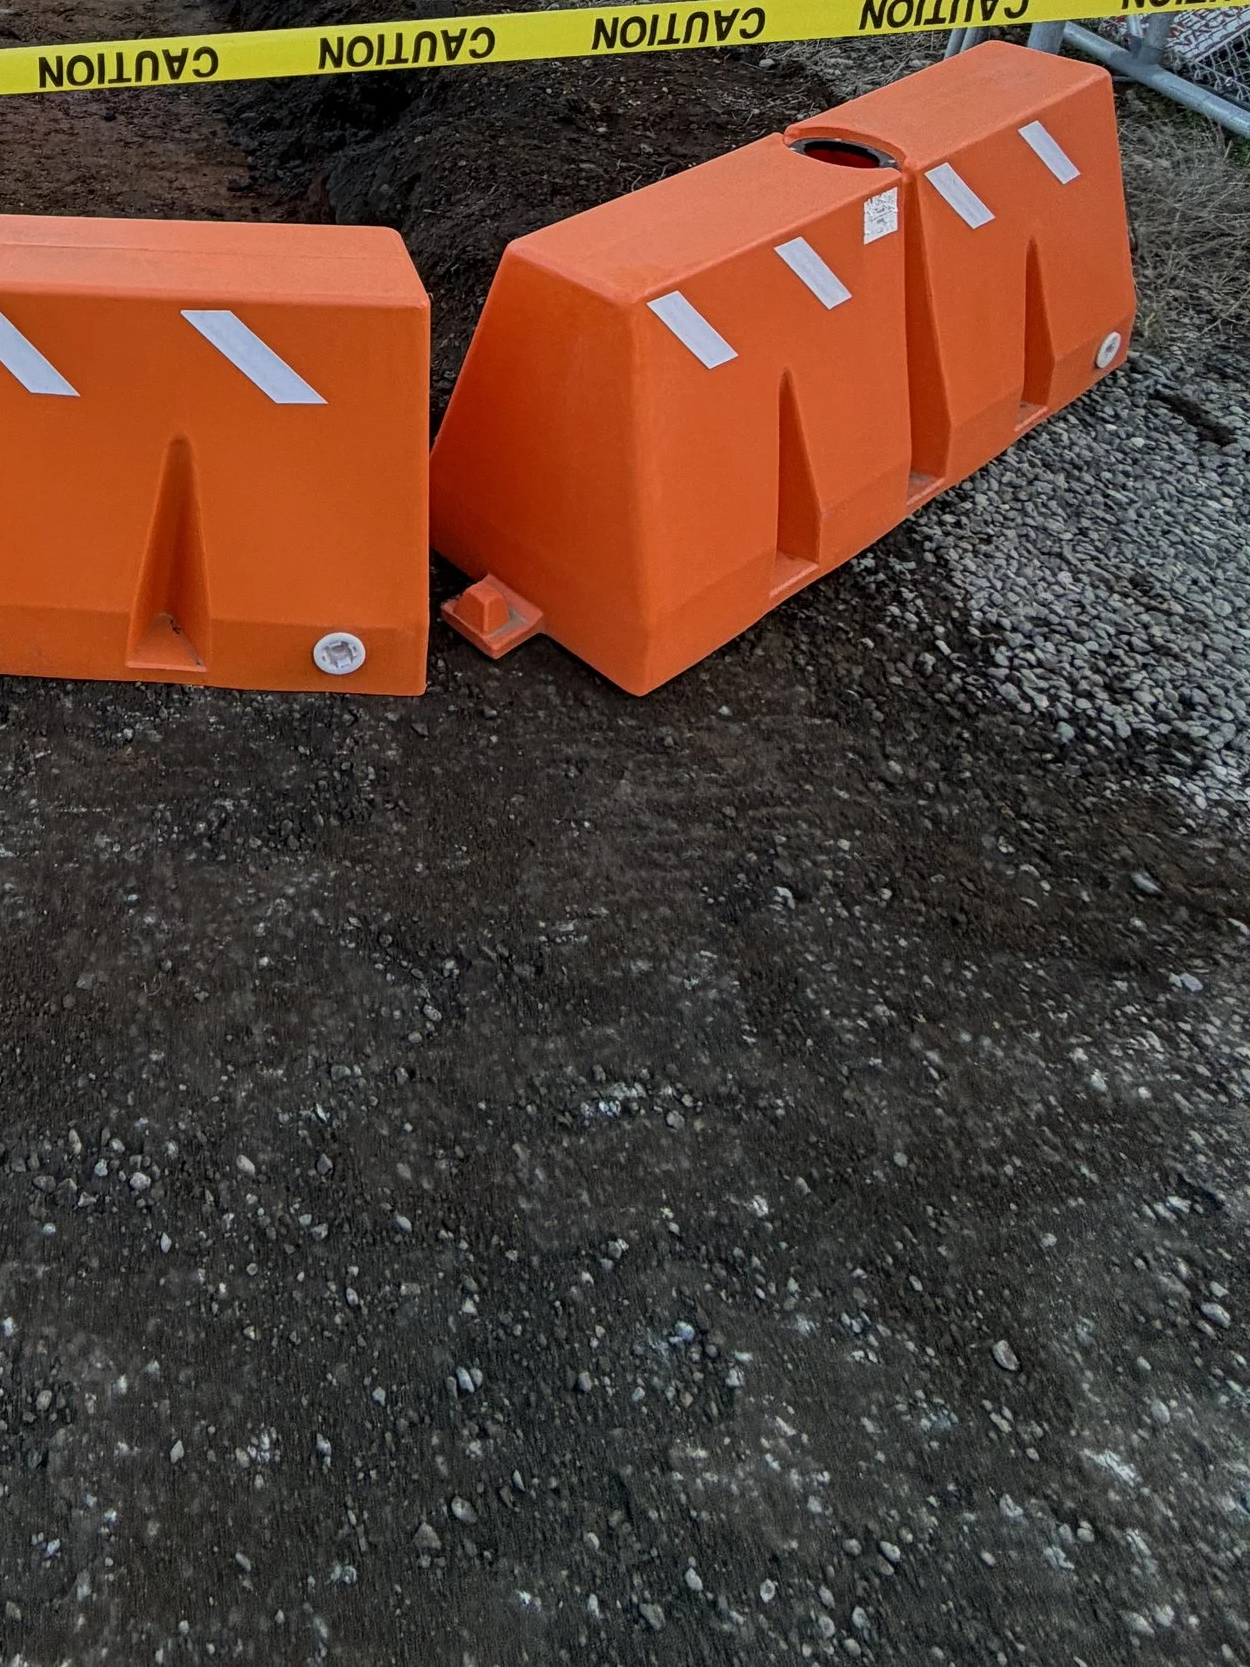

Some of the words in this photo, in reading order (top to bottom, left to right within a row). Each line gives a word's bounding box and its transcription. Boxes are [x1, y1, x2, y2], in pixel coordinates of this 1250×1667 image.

[319, 26, 496, 70] CAUTION
[592, 5, 766, 50] CAUTION
[38, 45, 219, 89] CAUTION
